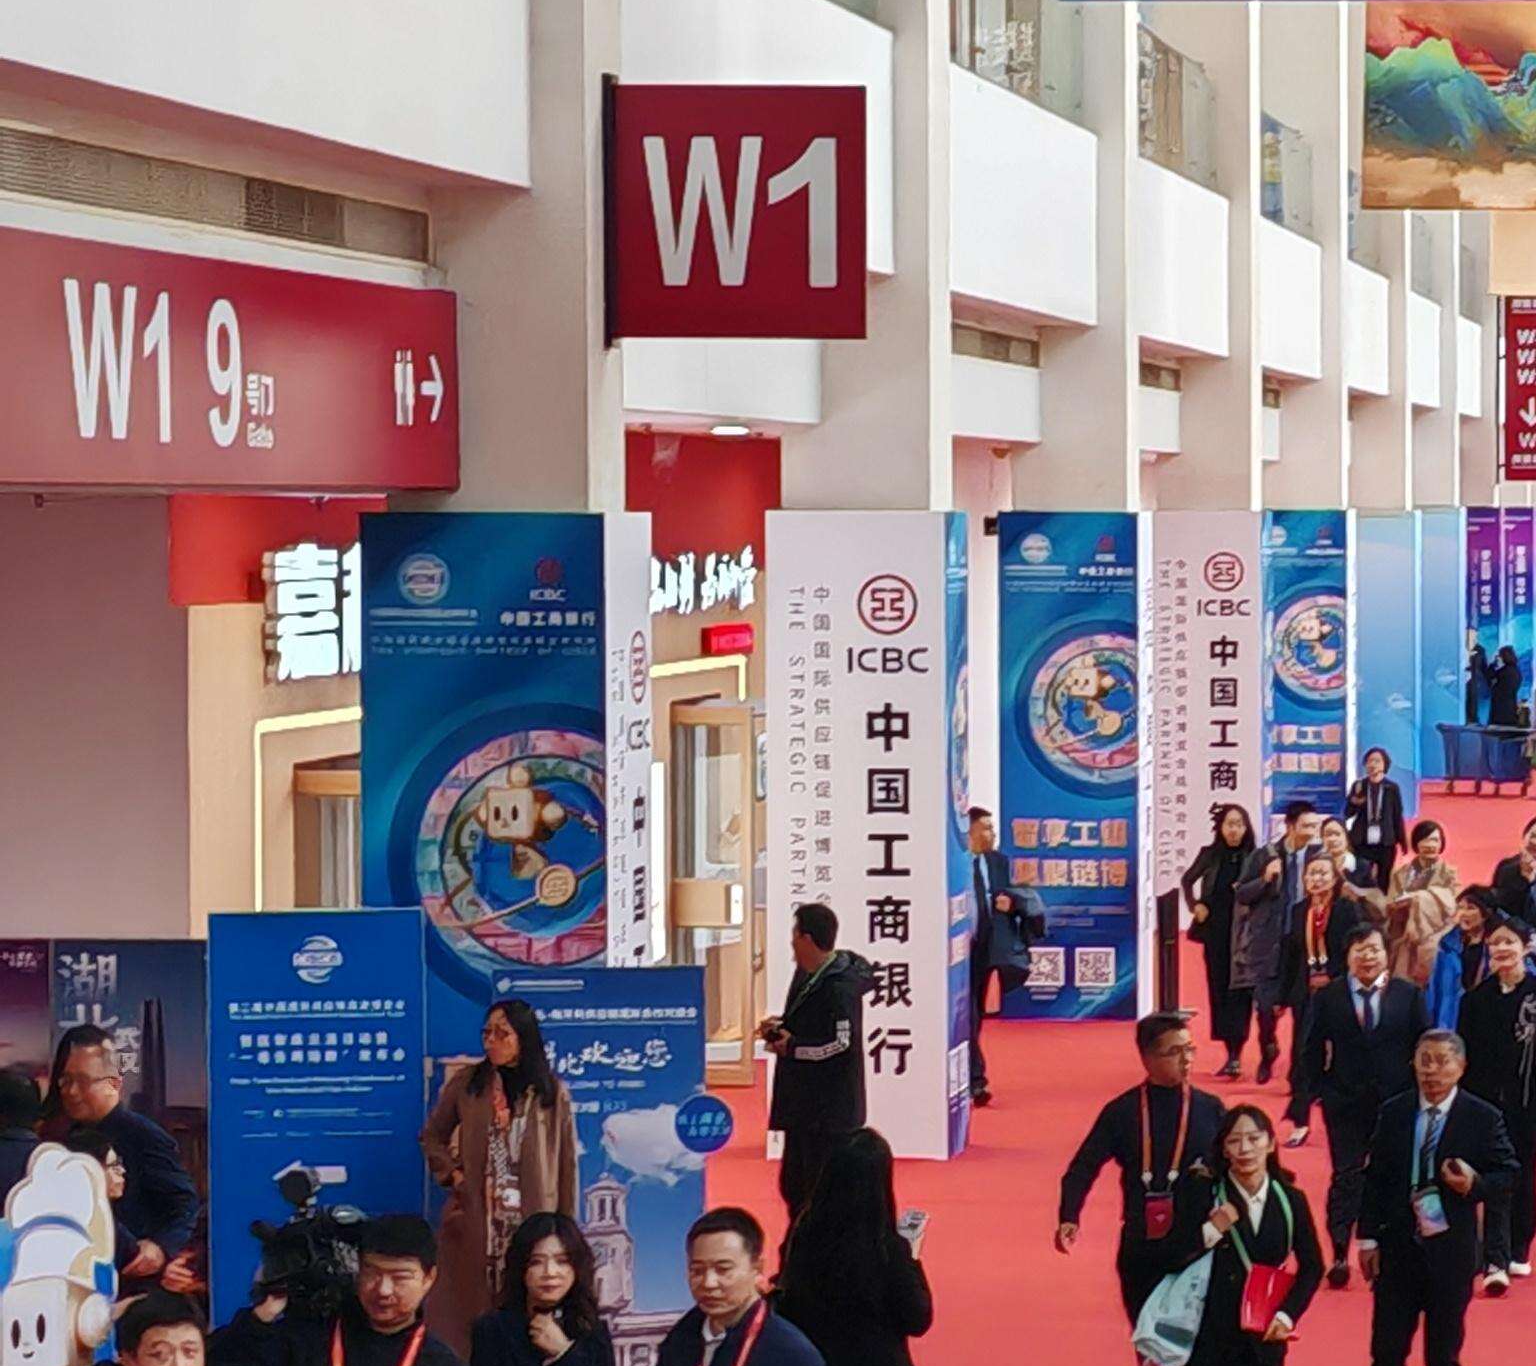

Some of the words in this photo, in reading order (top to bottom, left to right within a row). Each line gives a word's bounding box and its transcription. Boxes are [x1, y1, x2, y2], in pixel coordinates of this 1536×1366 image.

[642, 135, 839, 288] W1
[62, 277, 172, 444] W1
[846, 647, 929, 674] ICBC
[1197, 598, 1252, 617] ICBC
[788, 655, 807, 793] STRATEGIC
[790, 817, 807, 912] PARTNE
[866, 702, 913, 1076] 中国工商银行
